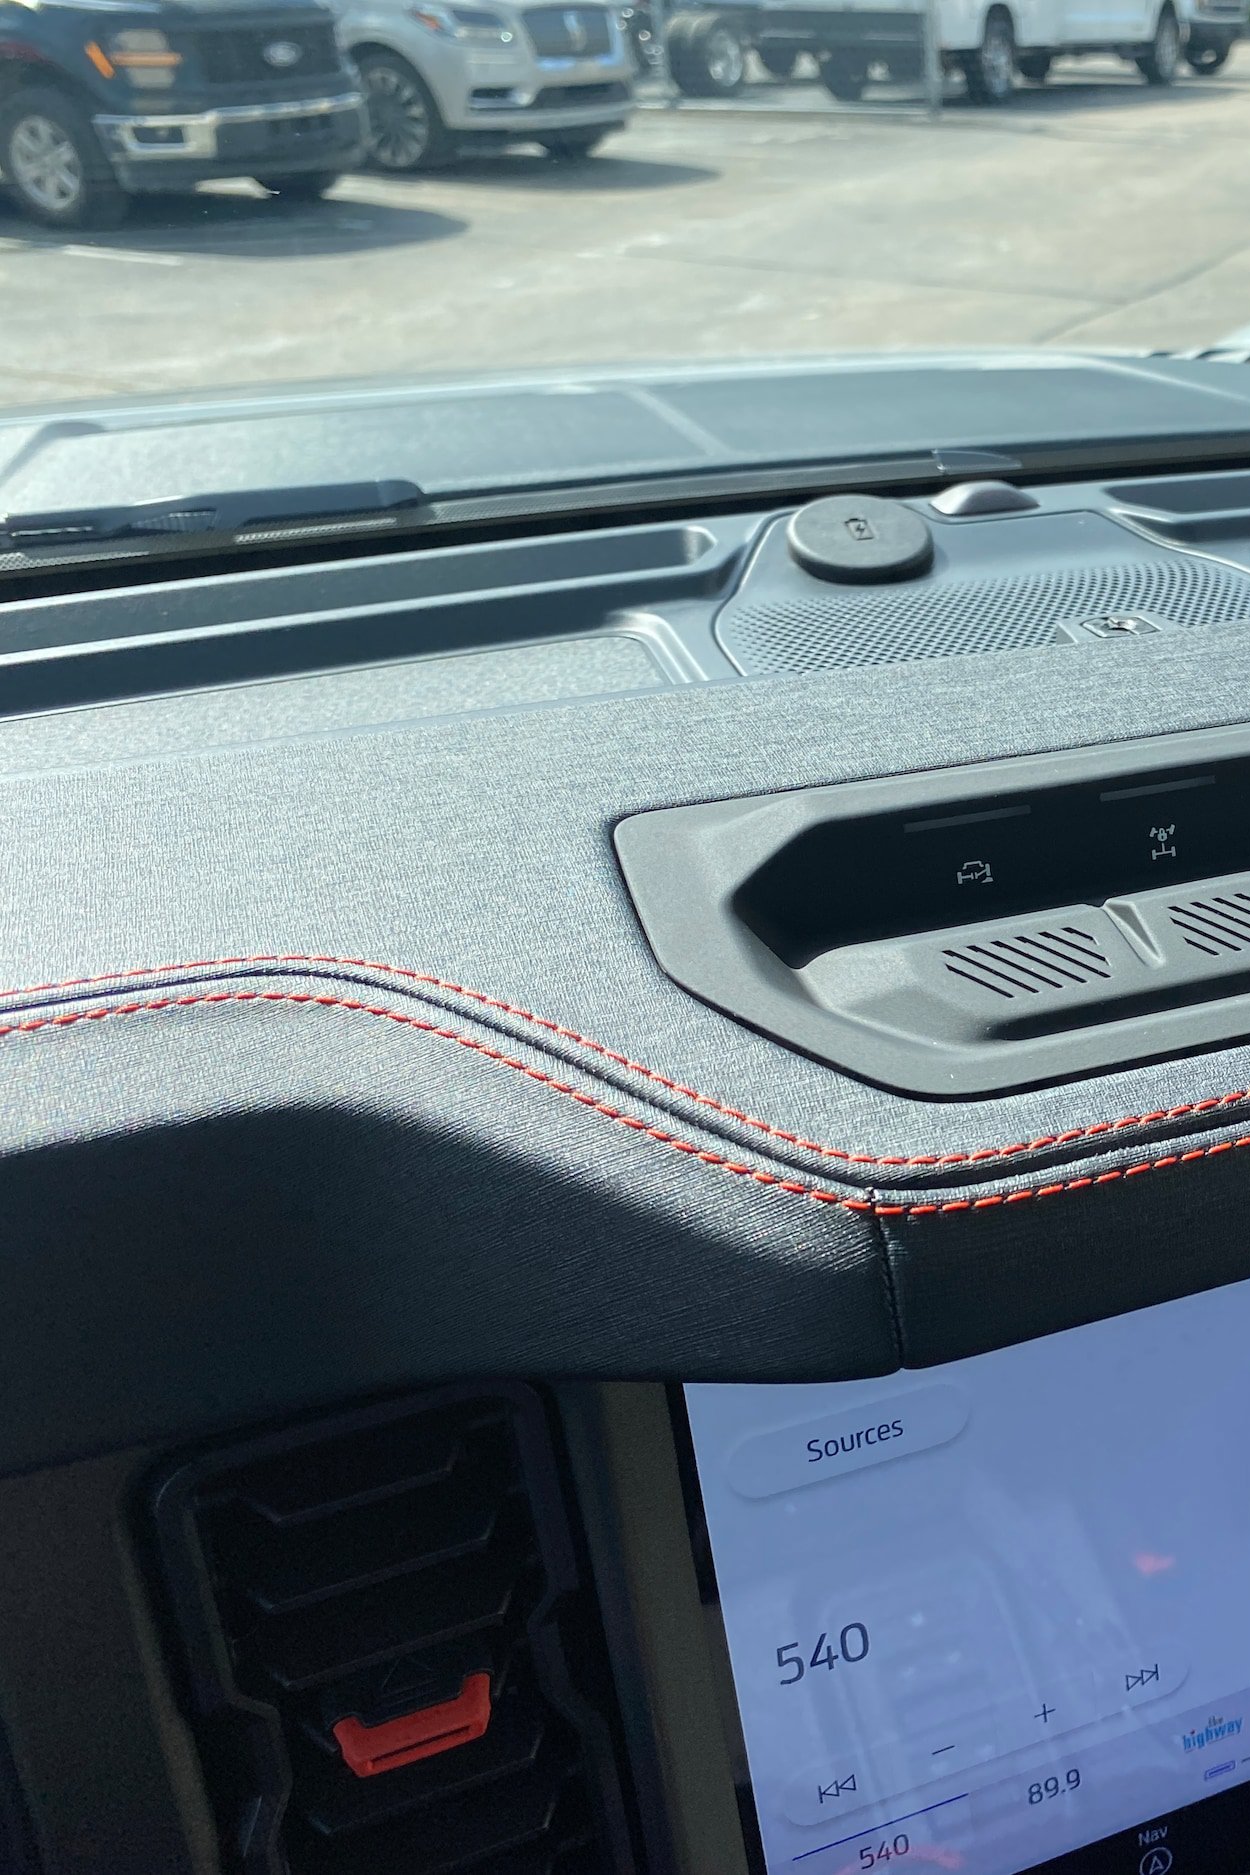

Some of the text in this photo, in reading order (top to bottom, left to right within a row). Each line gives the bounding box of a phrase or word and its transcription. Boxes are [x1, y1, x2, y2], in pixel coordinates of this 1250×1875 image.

[807, 1419, 904, 1463] Sources
[776, 1621, 870, 1686] 540
[1183, 1717, 1243, 1751] highway
[1027, 1768, 1081, 1805] 89.9
[859, 1833, 910, 1870] 540
[1138, 1826, 1168, 1847] Nav
